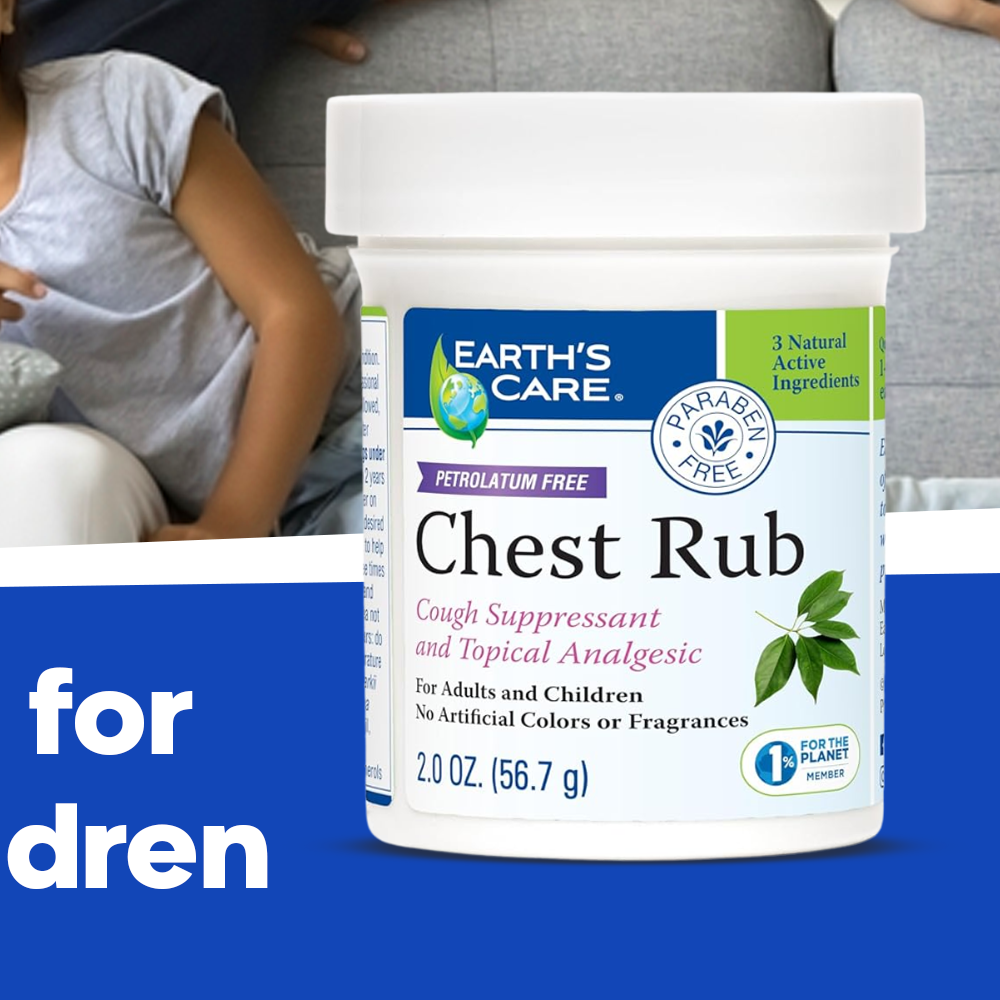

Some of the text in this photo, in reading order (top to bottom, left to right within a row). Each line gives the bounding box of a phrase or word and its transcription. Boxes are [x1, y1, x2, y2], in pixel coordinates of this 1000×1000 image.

[772, 332, 847, 351] 3 Natural
[772, 354, 826, 371] Active
[772, 373, 860, 394] Ingredients
[666, 390, 766, 442] PARABEN
[369, 471, 386, 488] years
[434, 469, 590, 492] PETROLATUM FREE
[677, 454, 743, 483] FREE
[416, 509, 805, 580] Chest Rub
[416, 598, 662, 634] Cough Suppressant
[415, 635, 703, 672] and Topical Analgesic
[415, 677, 644, 703] For Adults and Children
[415, 703, 750, 735] No Artificial Colors or Fragrances
[800, 736, 850, 751] FOR THE
[800, 747, 850, 764] PLANET
[417, 751, 589, 800] 2.0 OZ. (56.7 g)
[806, 768, 845, 782] MEMBER
